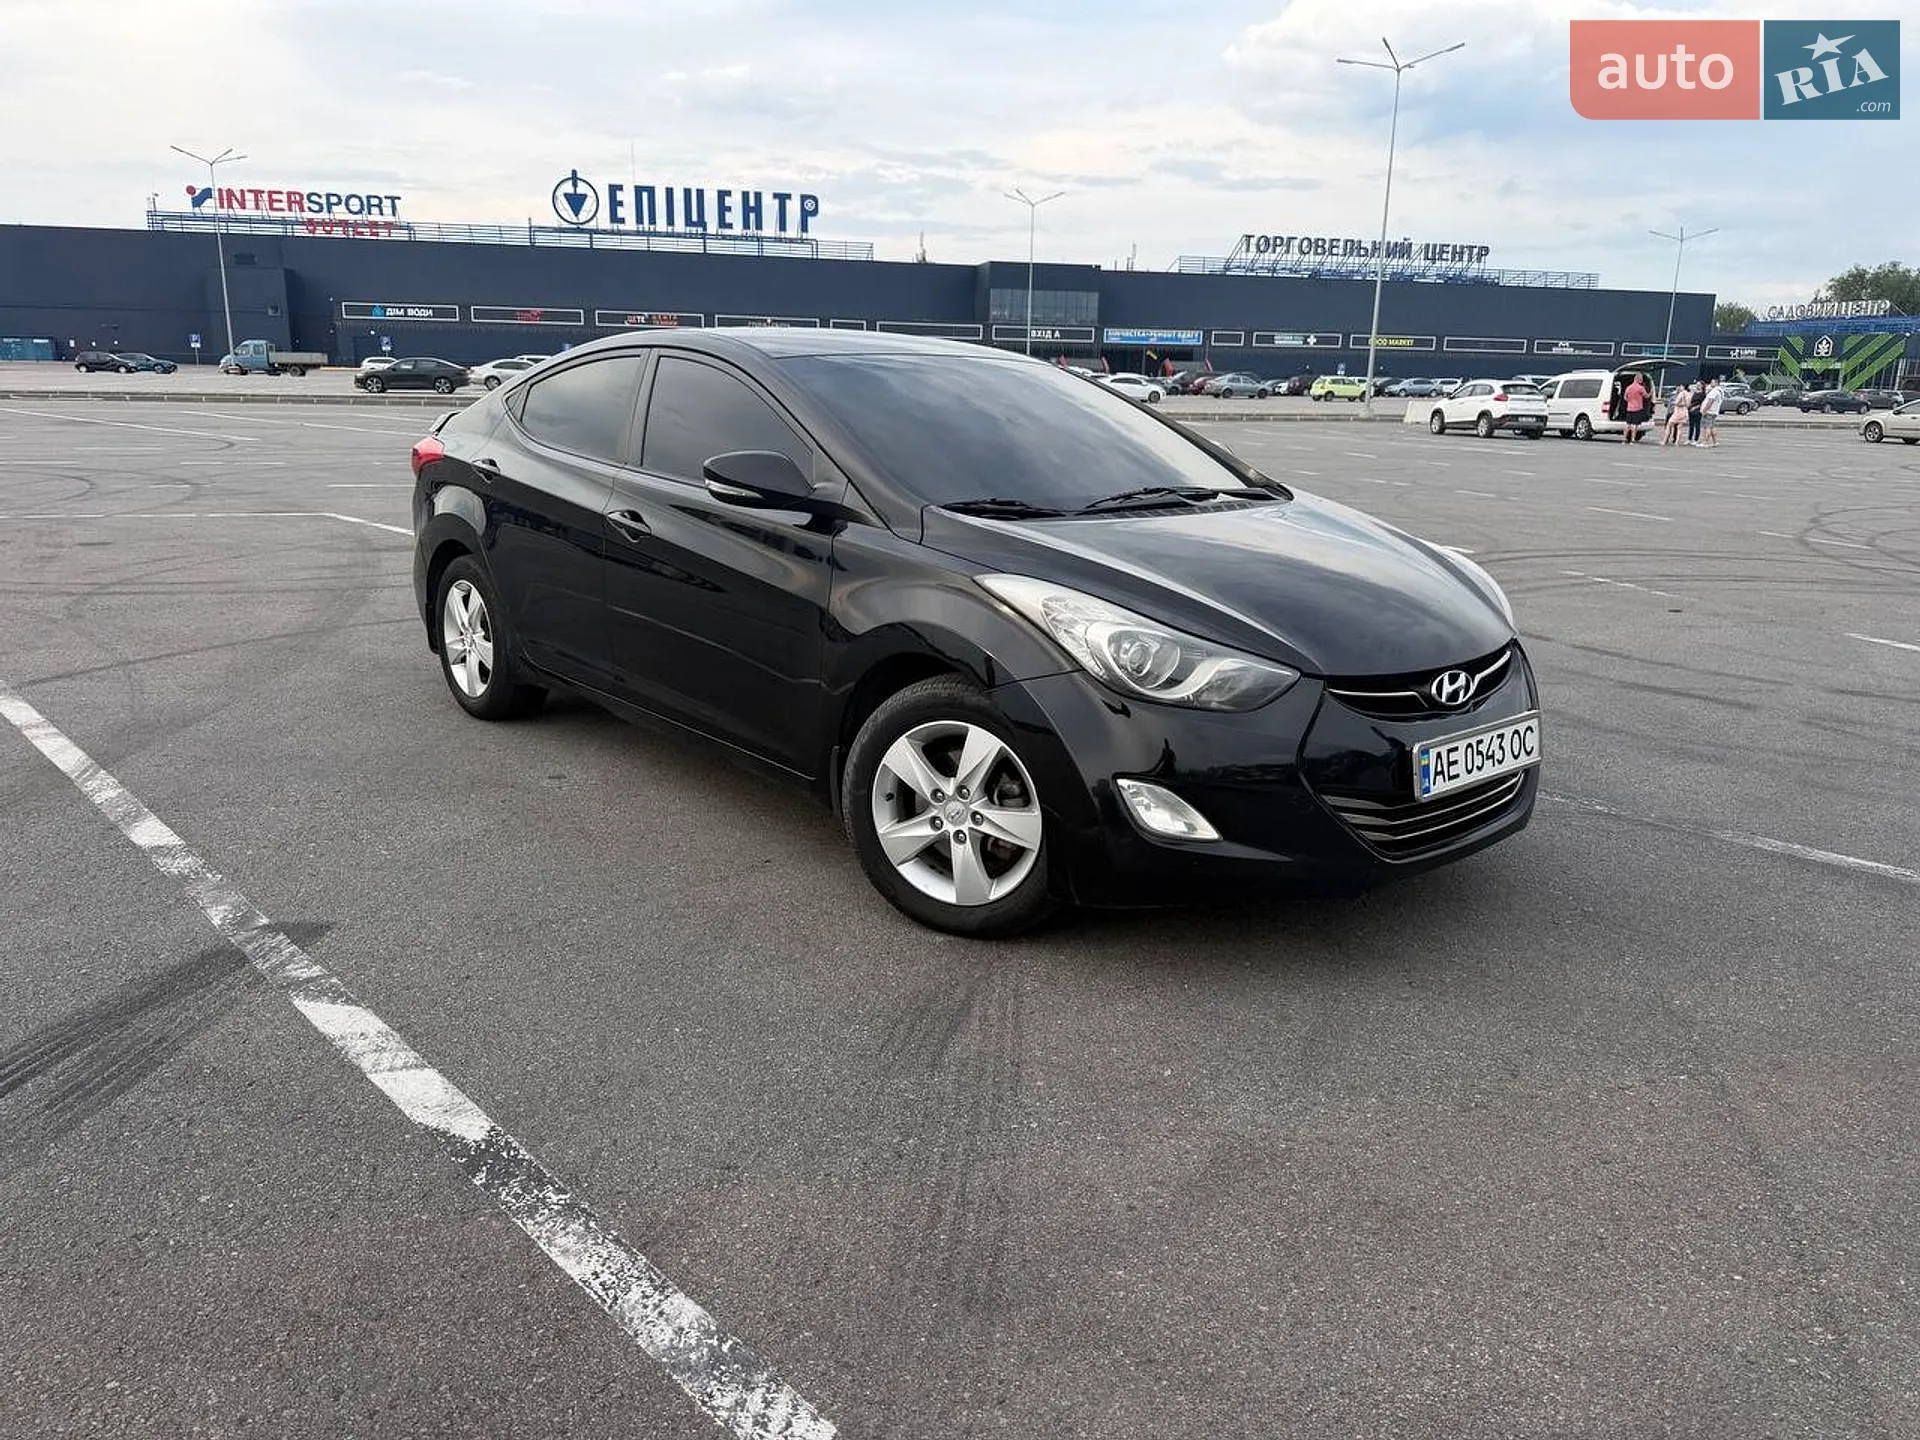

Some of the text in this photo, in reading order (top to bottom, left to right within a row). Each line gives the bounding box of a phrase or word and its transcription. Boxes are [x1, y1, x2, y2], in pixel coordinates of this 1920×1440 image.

[217, 187, 401, 217] INTERSPORT
[608, 183, 820, 234] ЕПІЦЕНТР
[304, 219, 395, 237] OUTLET
[1242, 234, 1490, 264] ТОРГОВЕЛЬНИЙ ЦЕНТР
[385, 307, 433, 318] ДІМ ВОДИ
[1432, 725, 1535, 787] AE 0543 OC
